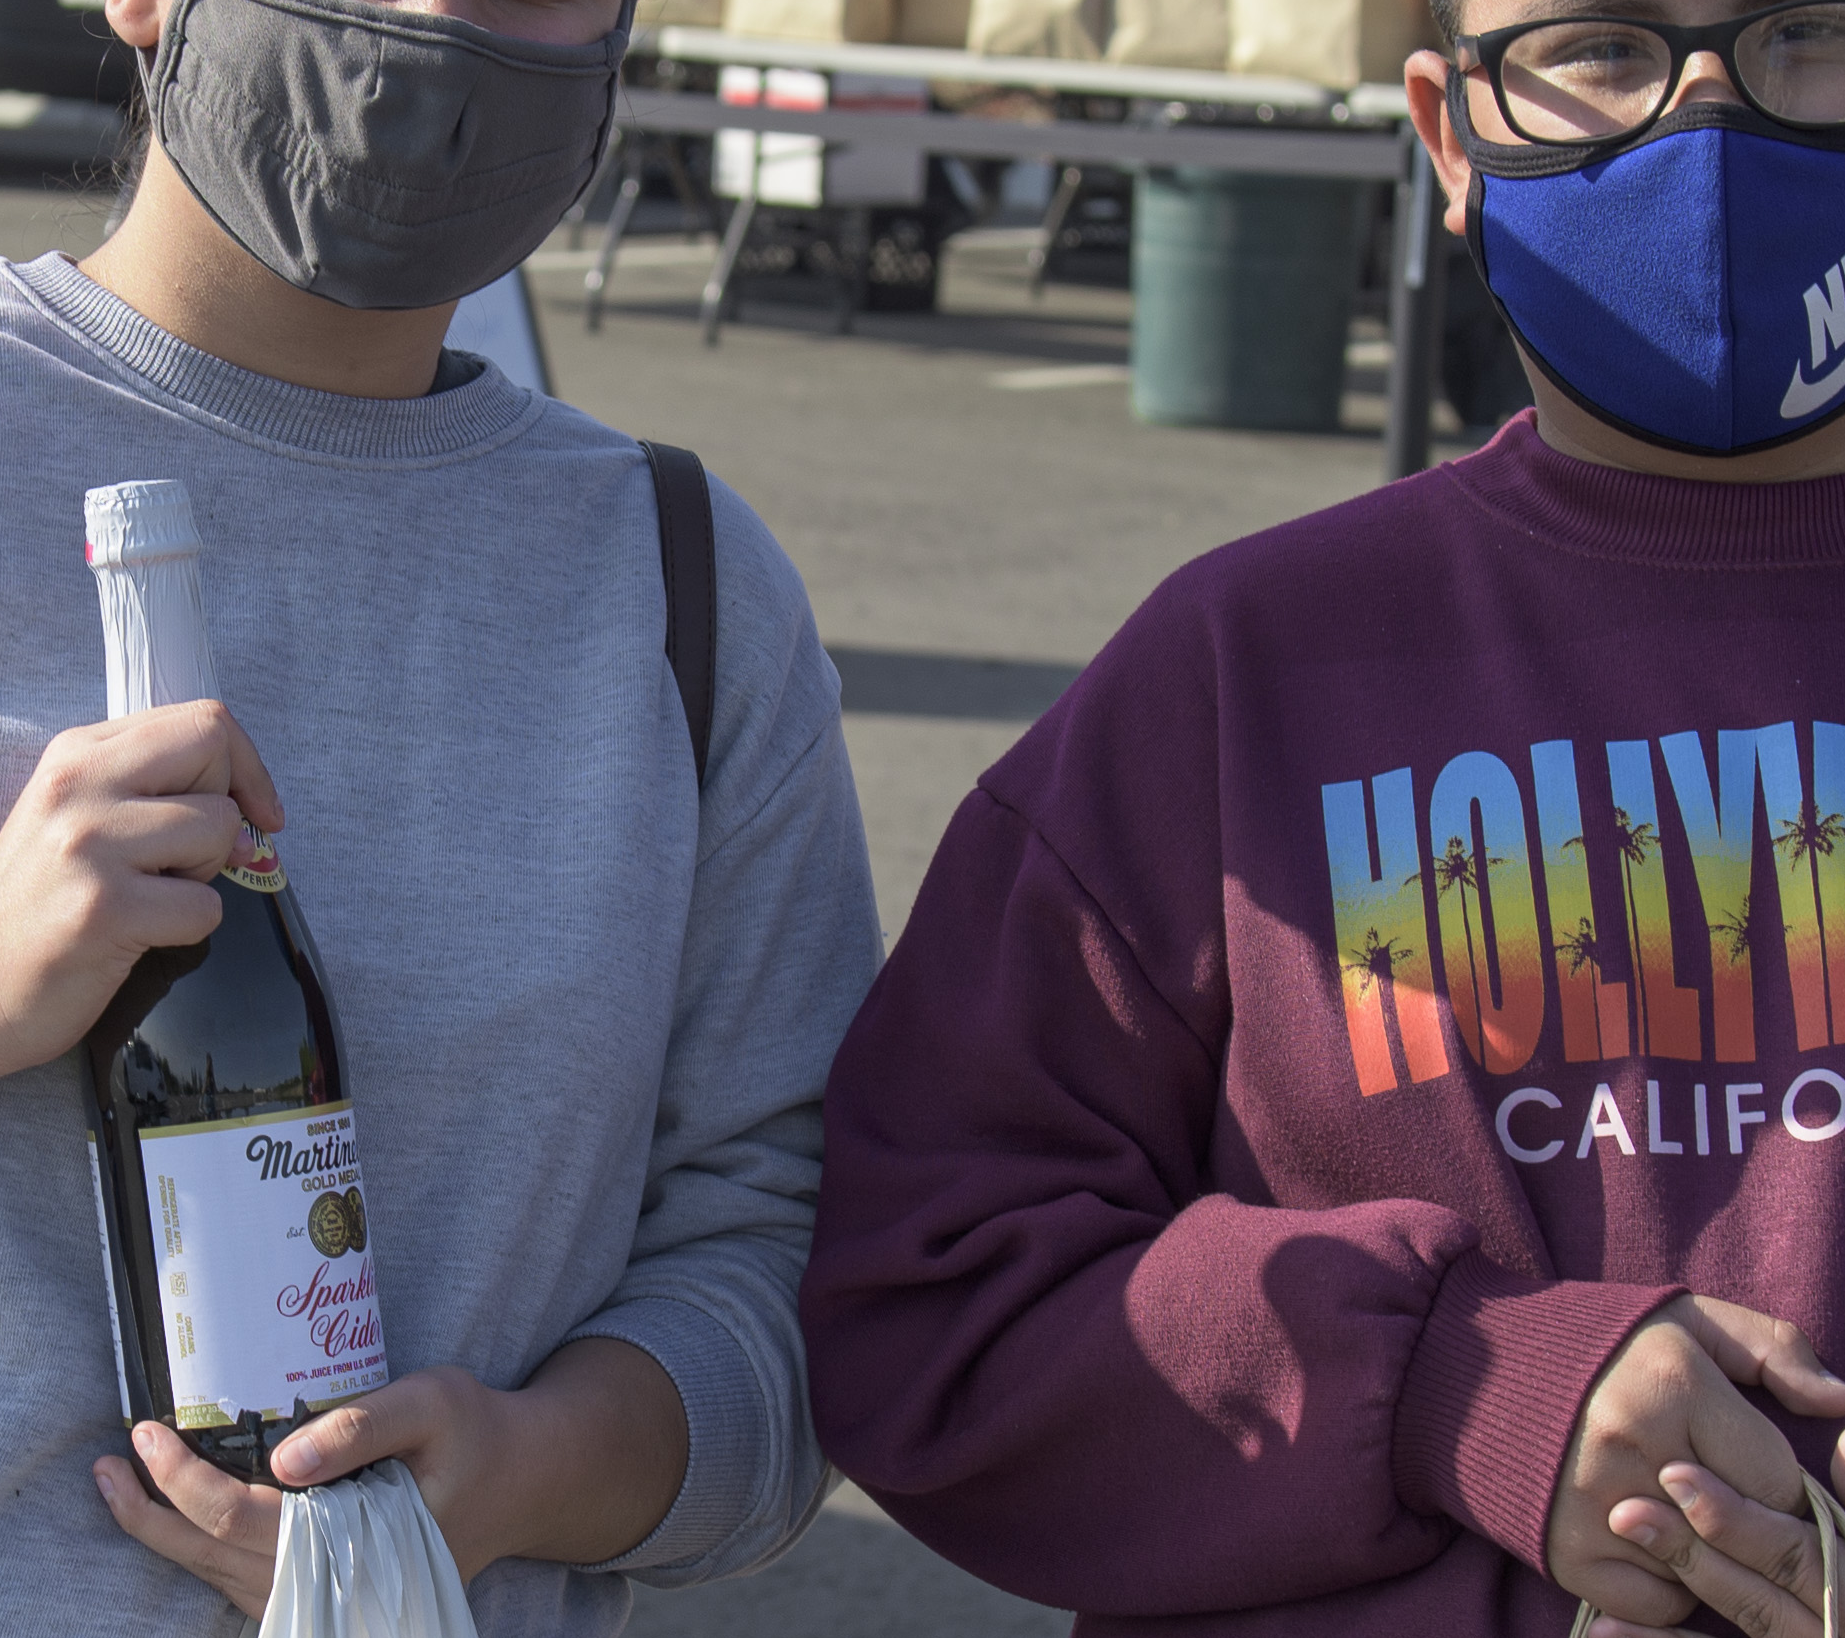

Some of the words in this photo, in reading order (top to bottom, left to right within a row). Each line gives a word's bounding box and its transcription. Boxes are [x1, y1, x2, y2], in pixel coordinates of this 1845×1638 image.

[242, 871, 280, 888] PERFECT
[307, 1120, 336, 1136] SINCE
[302, 1174, 336, 1192] GOLD
[163, 1210, 171, 1226] FOR
[167, 1177, 180, 1229] REFRIGERATE
[174, 1229, 183, 1255] AFTER
[164, 1226, 175, 1259] QUALITY
[185, 1316, 196, 1355] CONTAINS
[310, 1309, 381, 1358] Cider
[285, 1371, 309, 1383] 100%
[310, 1365, 332, 1379] JUICE
[333, 1361, 353, 1375] FROM
[329, 1379, 349, 1393] 25.4
